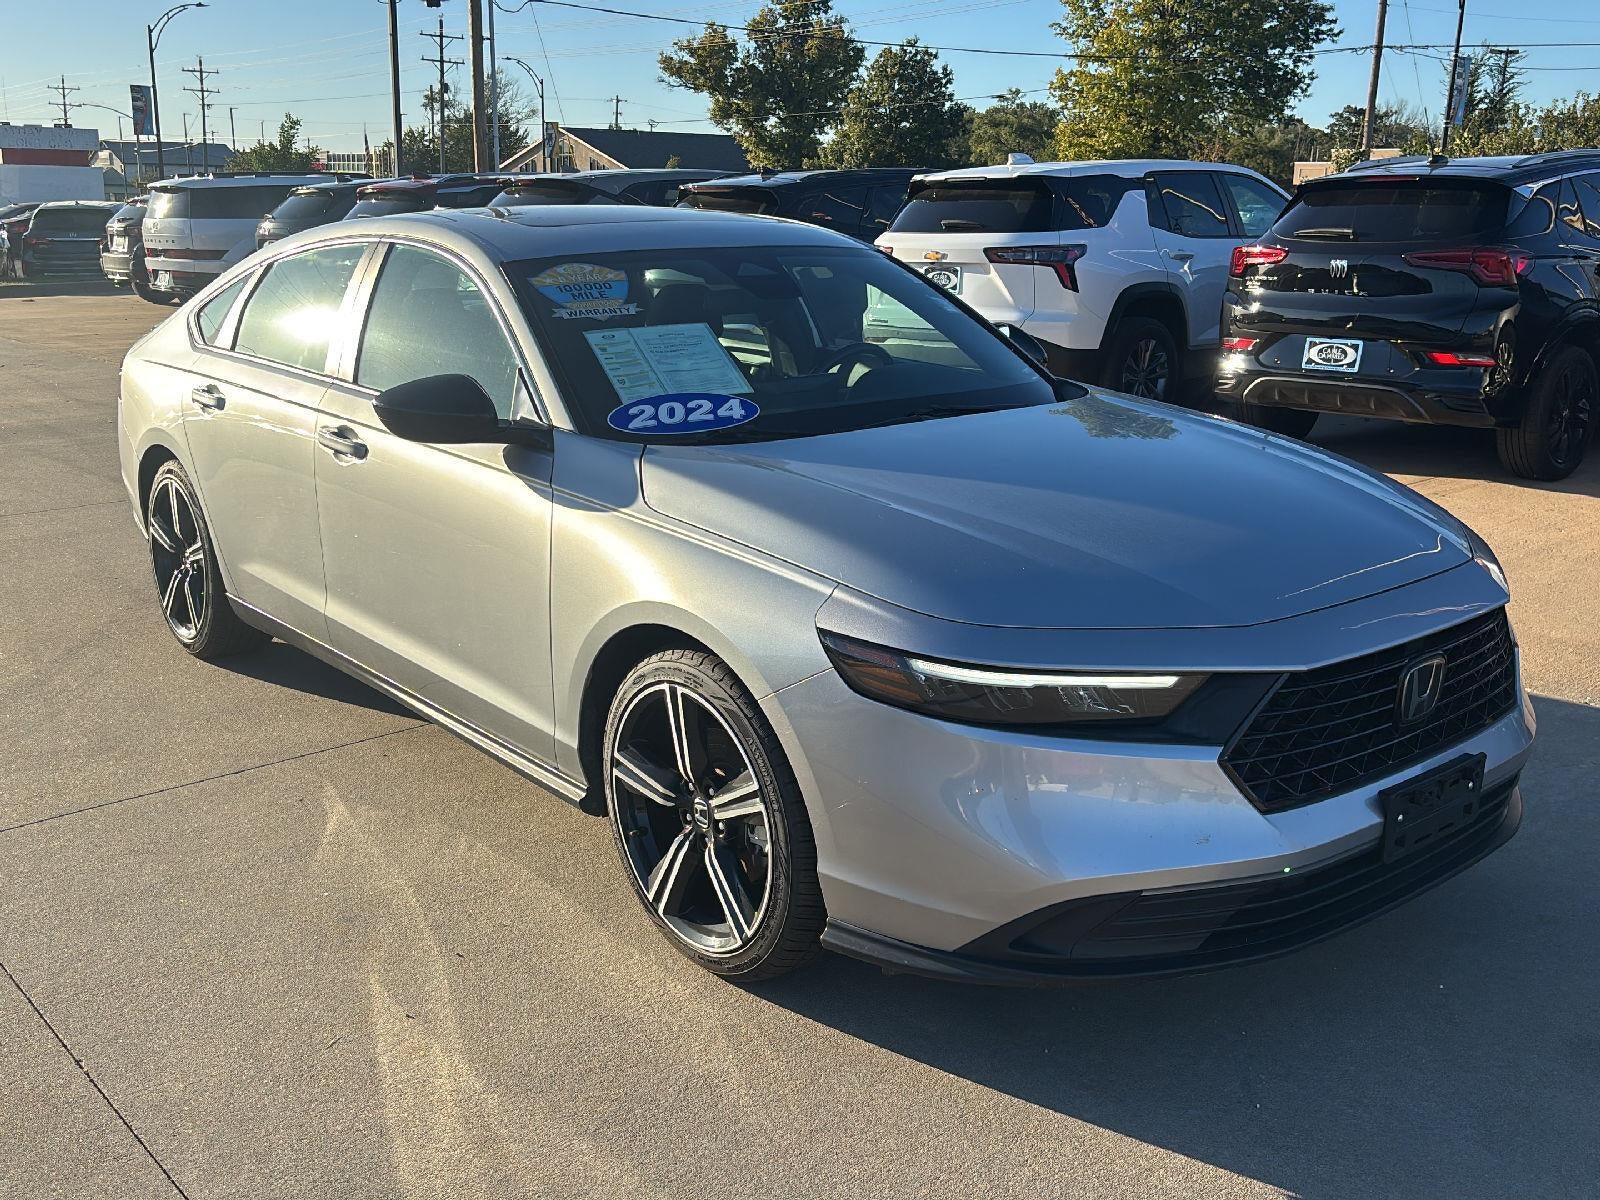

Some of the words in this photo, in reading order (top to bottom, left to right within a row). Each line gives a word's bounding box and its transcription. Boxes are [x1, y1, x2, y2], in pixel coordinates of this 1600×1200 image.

[571, 290, 609, 300] MILE
[566, 306, 631, 318] WARRANTY
[627, 398, 747, 430] 2024
